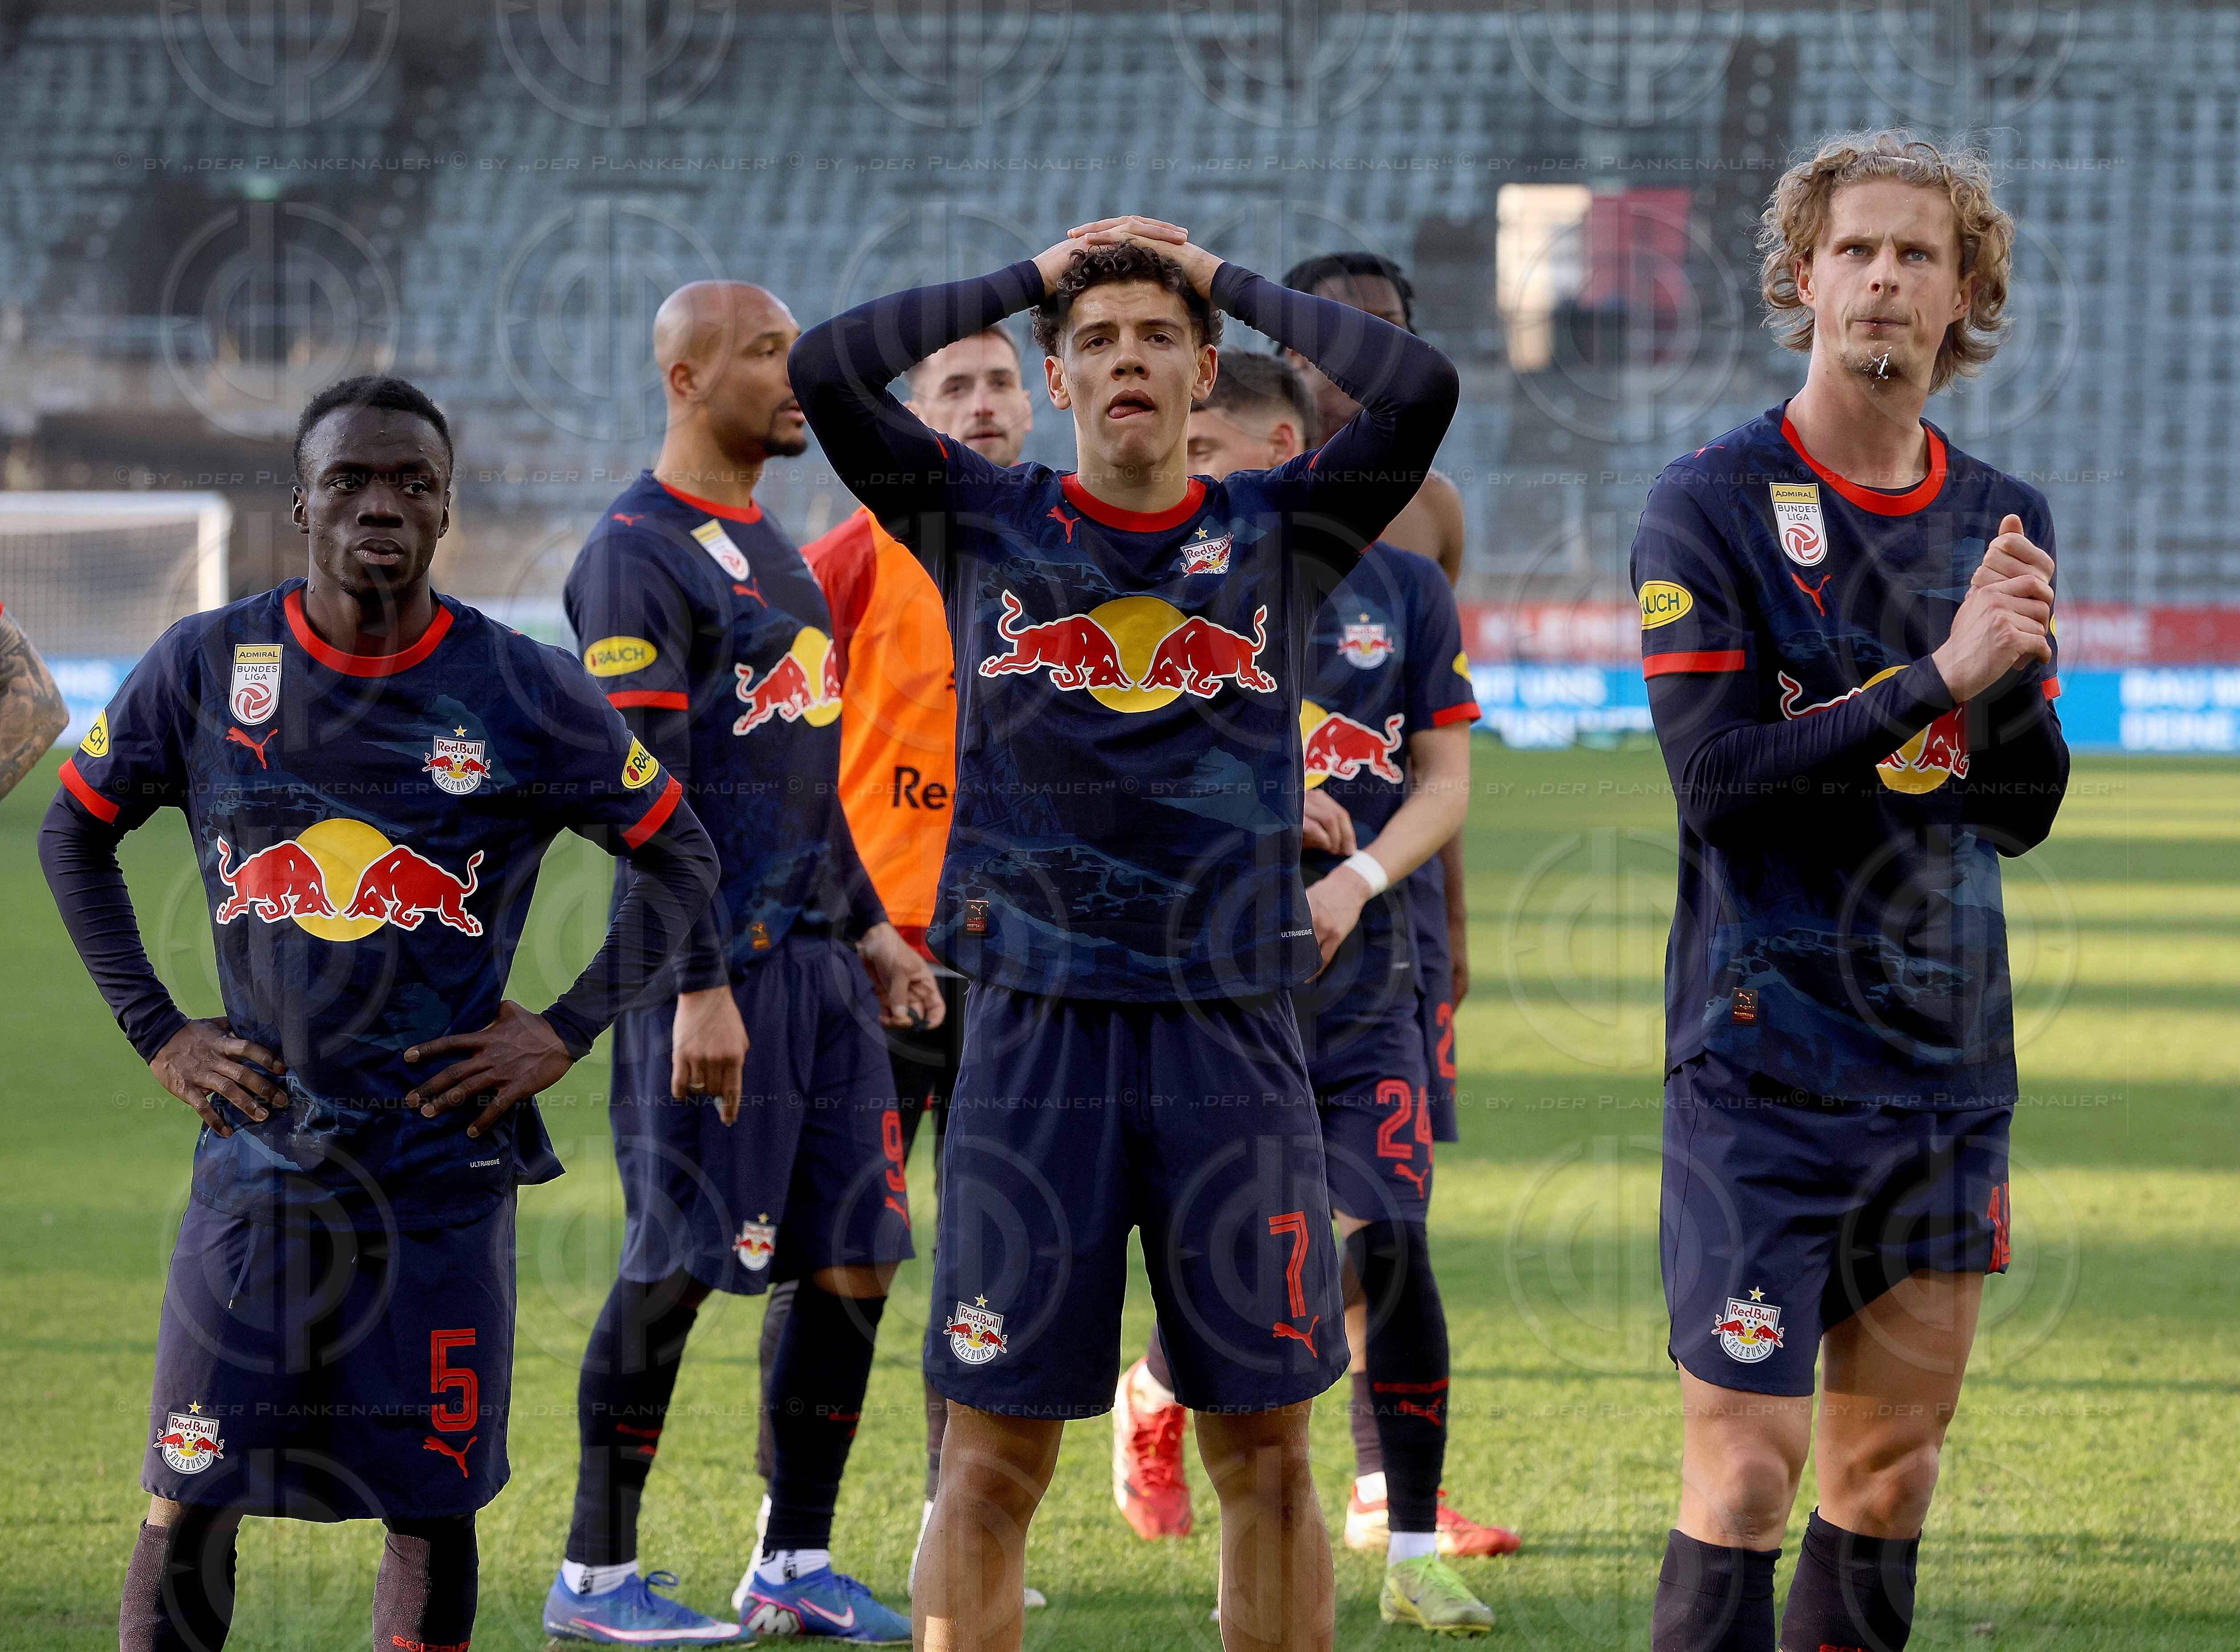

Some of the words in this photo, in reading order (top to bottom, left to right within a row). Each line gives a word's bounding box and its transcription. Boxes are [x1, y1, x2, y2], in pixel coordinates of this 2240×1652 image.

[1775, 490, 1815, 498] ADMIRAL
[1778, 505, 1817, 513] BUNDES
[438, 741, 458, 752] Red
[460, 743, 480, 755] Bull
[437, 773, 475, 791] SALZBURG
[893, 767, 947, 809] Re
[1281, 928, 1313, 937] ULTRAWEAVE
[470, 1158, 500, 1168] ULTRAWEAVE
[1269, 1211, 1309, 1318] 7
[961, 1308, 979, 1321] Red
[980, 1313, 999, 1328] Bull
[1731, 1304, 1753, 1317] Red
[1754, 1308, 1776, 1322] Bull
[956, 1340, 991, 1360] SALZBURG
[1726, 1338, 1767, 1357] SALZBURG
[431, 1328, 478, 1432] 5
[171, 1418, 191, 1430] Red
[194, 1421, 214, 1434] Bull
[167, 1450, 207, 1469] SALZBURG
